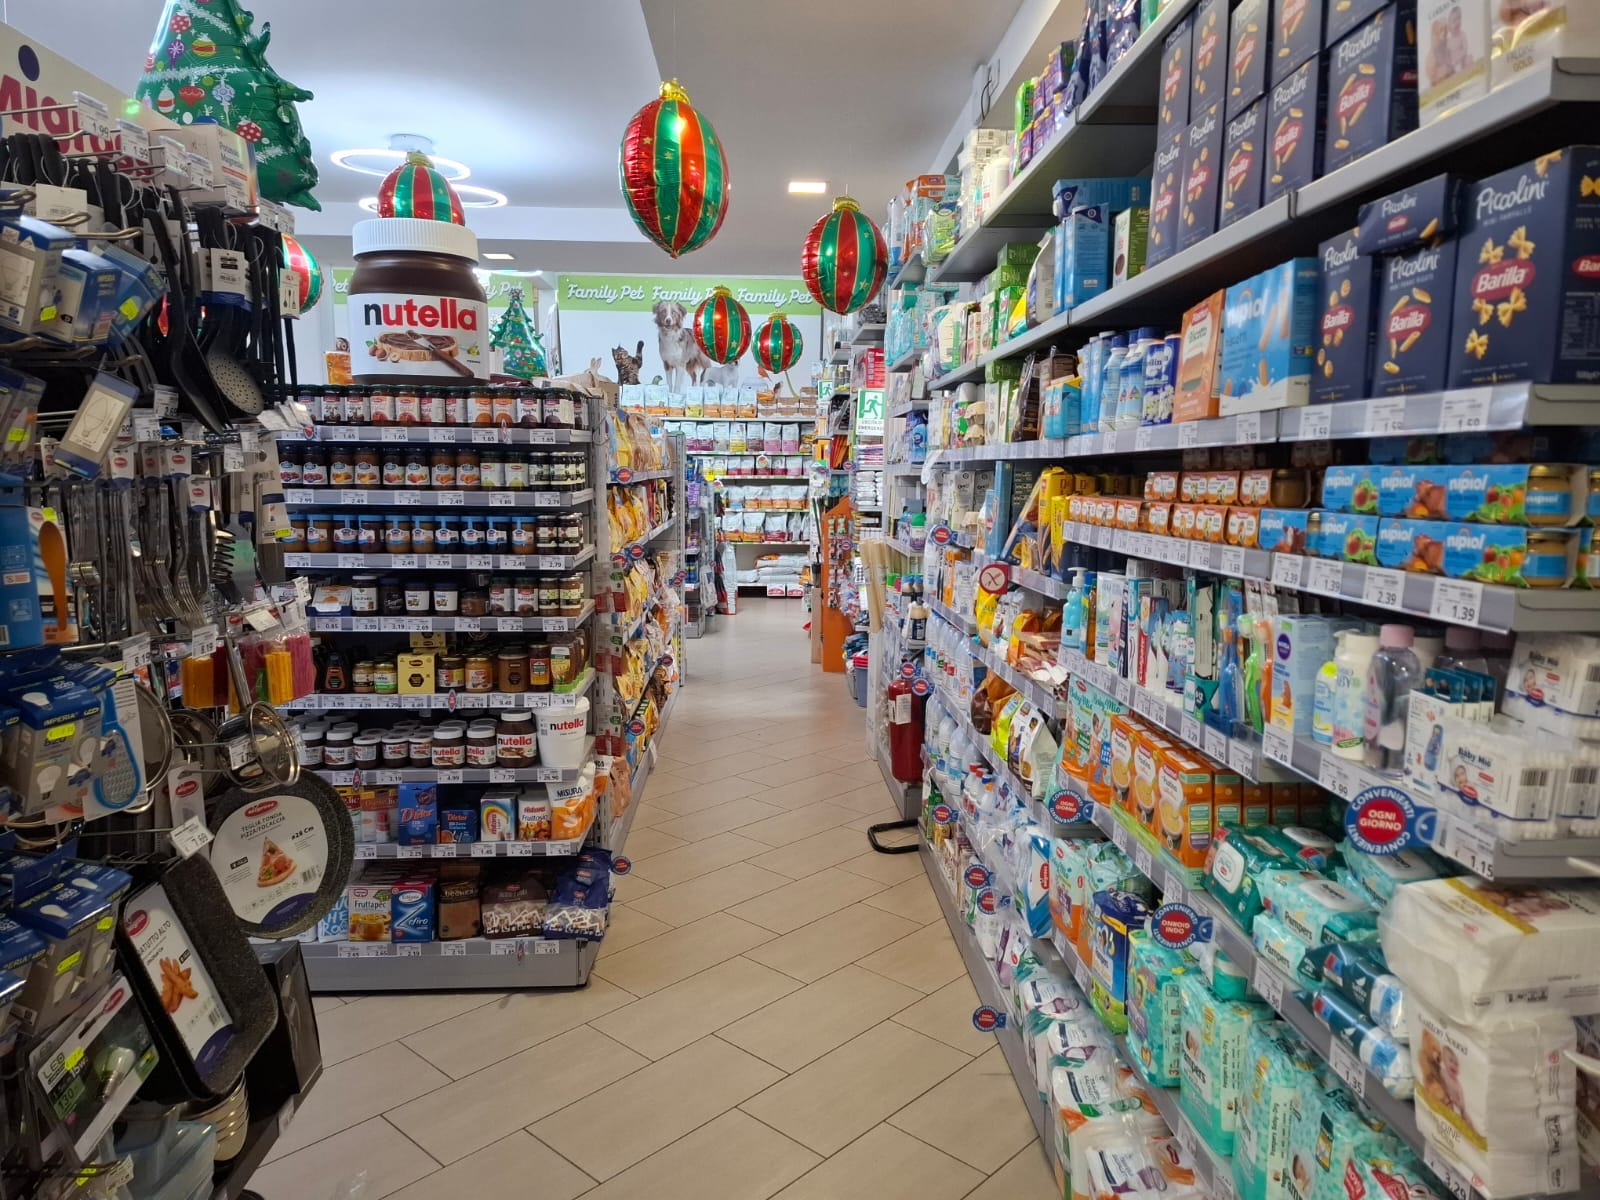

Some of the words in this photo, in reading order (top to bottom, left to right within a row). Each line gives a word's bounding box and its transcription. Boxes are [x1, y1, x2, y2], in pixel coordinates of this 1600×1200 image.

[1340, 83, 1370, 112] Barilla
[1274, 125, 1300, 152] Barilla
[1382, 193, 1417, 218] Piccolini
[1476, 174, 1549, 220] Piccolini
[1324, 240, 1359, 272] Piccolin
[1389, 248, 1441, 284] Piccolini
[1476, 266, 1529, 294] Barilla
[567, 284, 618, 304] Family
[620, 284, 645, 300] Pet
[652, 286, 703, 305] Family
[737, 287, 789, 309] Family
[789, 290, 813, 304] Pet
[364, 298, 478, 331] nutella
[1323, 311, 1351, 329] Barilla
[1389, 312, 1426, 333] Barilla
[1326, 472, 1354, 488] nipiol
[1381, 474, 1415, 490] nipiol
[1449, 475, 1488, 493] nipiol
[1321, 521, 1348, 536] nipiol
[1380, 526, 1413, 543] nipiol
[1447, 535, 1486, 552] nipiol
[1284, 572, 1298, 584] 2.39
[1324, 580, 1341, 593] 1.39
[1377, 591, 1397, 605] 2.39
[1452, 605, 1476, 622] 1.39
[550, 718, 584, 731] nutella
[497, 736, 533, 746] nutella
[1458, 747, 1475, 762] Baby
[1476, 756, 1492, 768] Mio
[556, 786, 583, 798] MISURA
[1331, 781, 1349, 797] 5.99
[1352, 788, 1416, 819] CONVENIENTI
[1359, 818, 1402, 831] GIORNO
[1368, 809, 1396, 821] OGNI
[1348, 824, 1411, 854] CONVENIENTI
[1470, 855, 1494, 877] 1.15
[1155, 904, 1198, 925] CONVENIENTI
[1284, 911, 1313, 942] Pampers
[1153, 928, 1196, 949] CONVENIENTI
[1264, 940, 1291, 969] Pampers
[1344, 1071, 1363, 1095] 1.35
